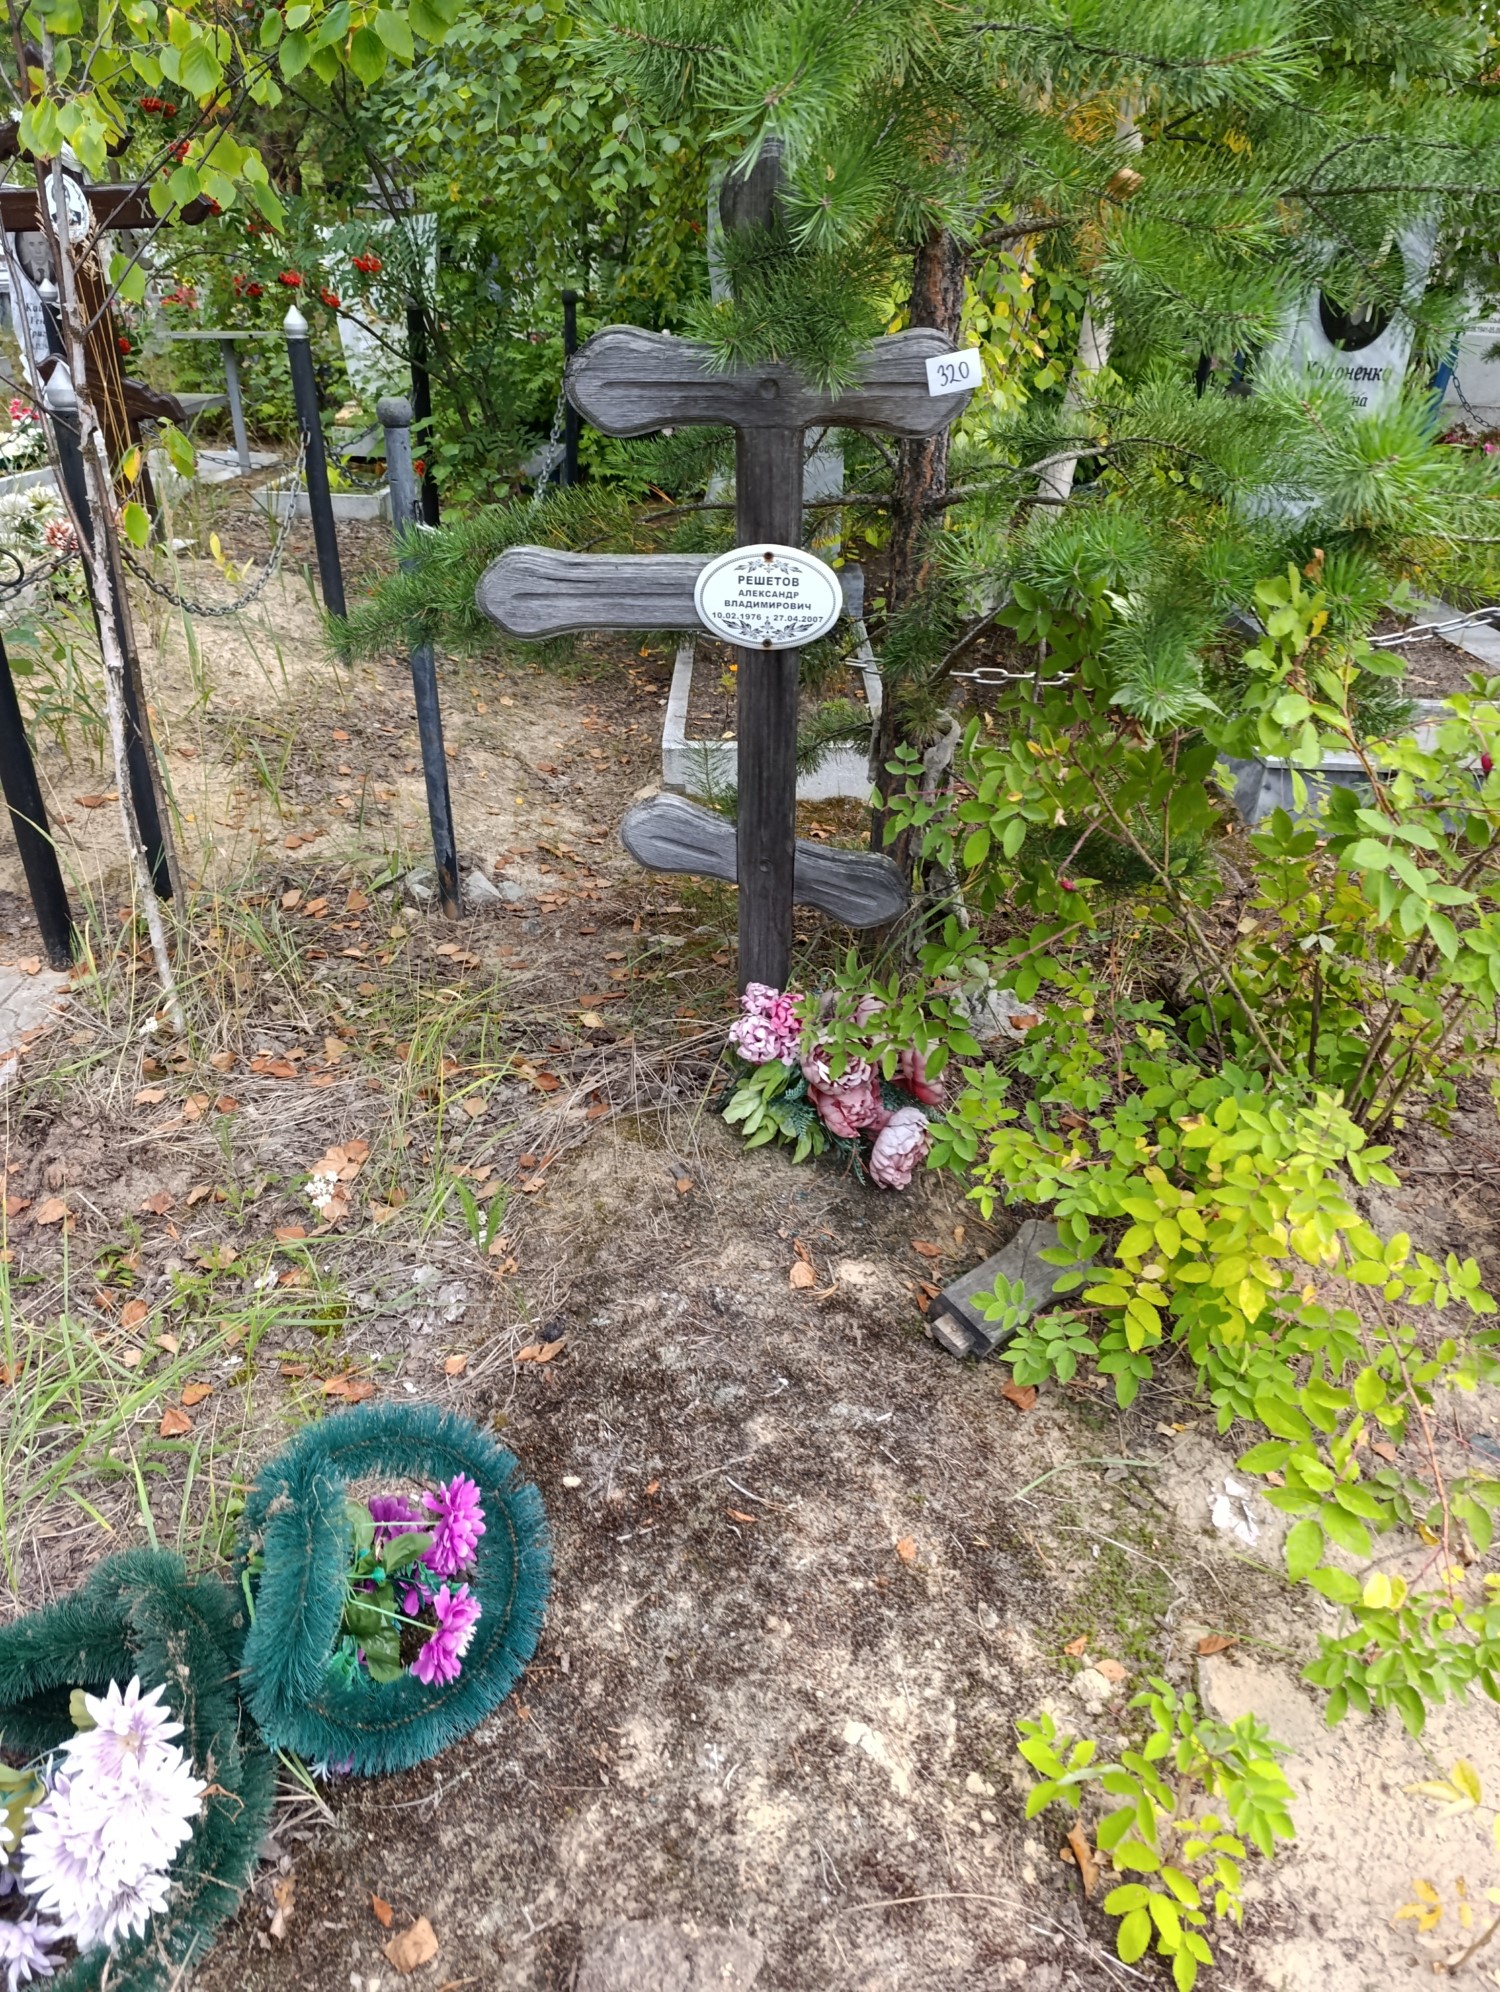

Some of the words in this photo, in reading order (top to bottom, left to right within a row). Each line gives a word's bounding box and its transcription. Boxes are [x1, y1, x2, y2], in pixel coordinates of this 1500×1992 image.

[936, 361, 970, 387] 320
[738, 575, 800, 587] РЕШЕТОВ
[738, 589, 800, 599] АЛЕКСАНДР
[724, 599, 812, 610] ВЛАДИМИРОВИЧ
[712, 612, 762, 621] 10.02.1976
[773, 614, 824, 623] 27.04.2007
